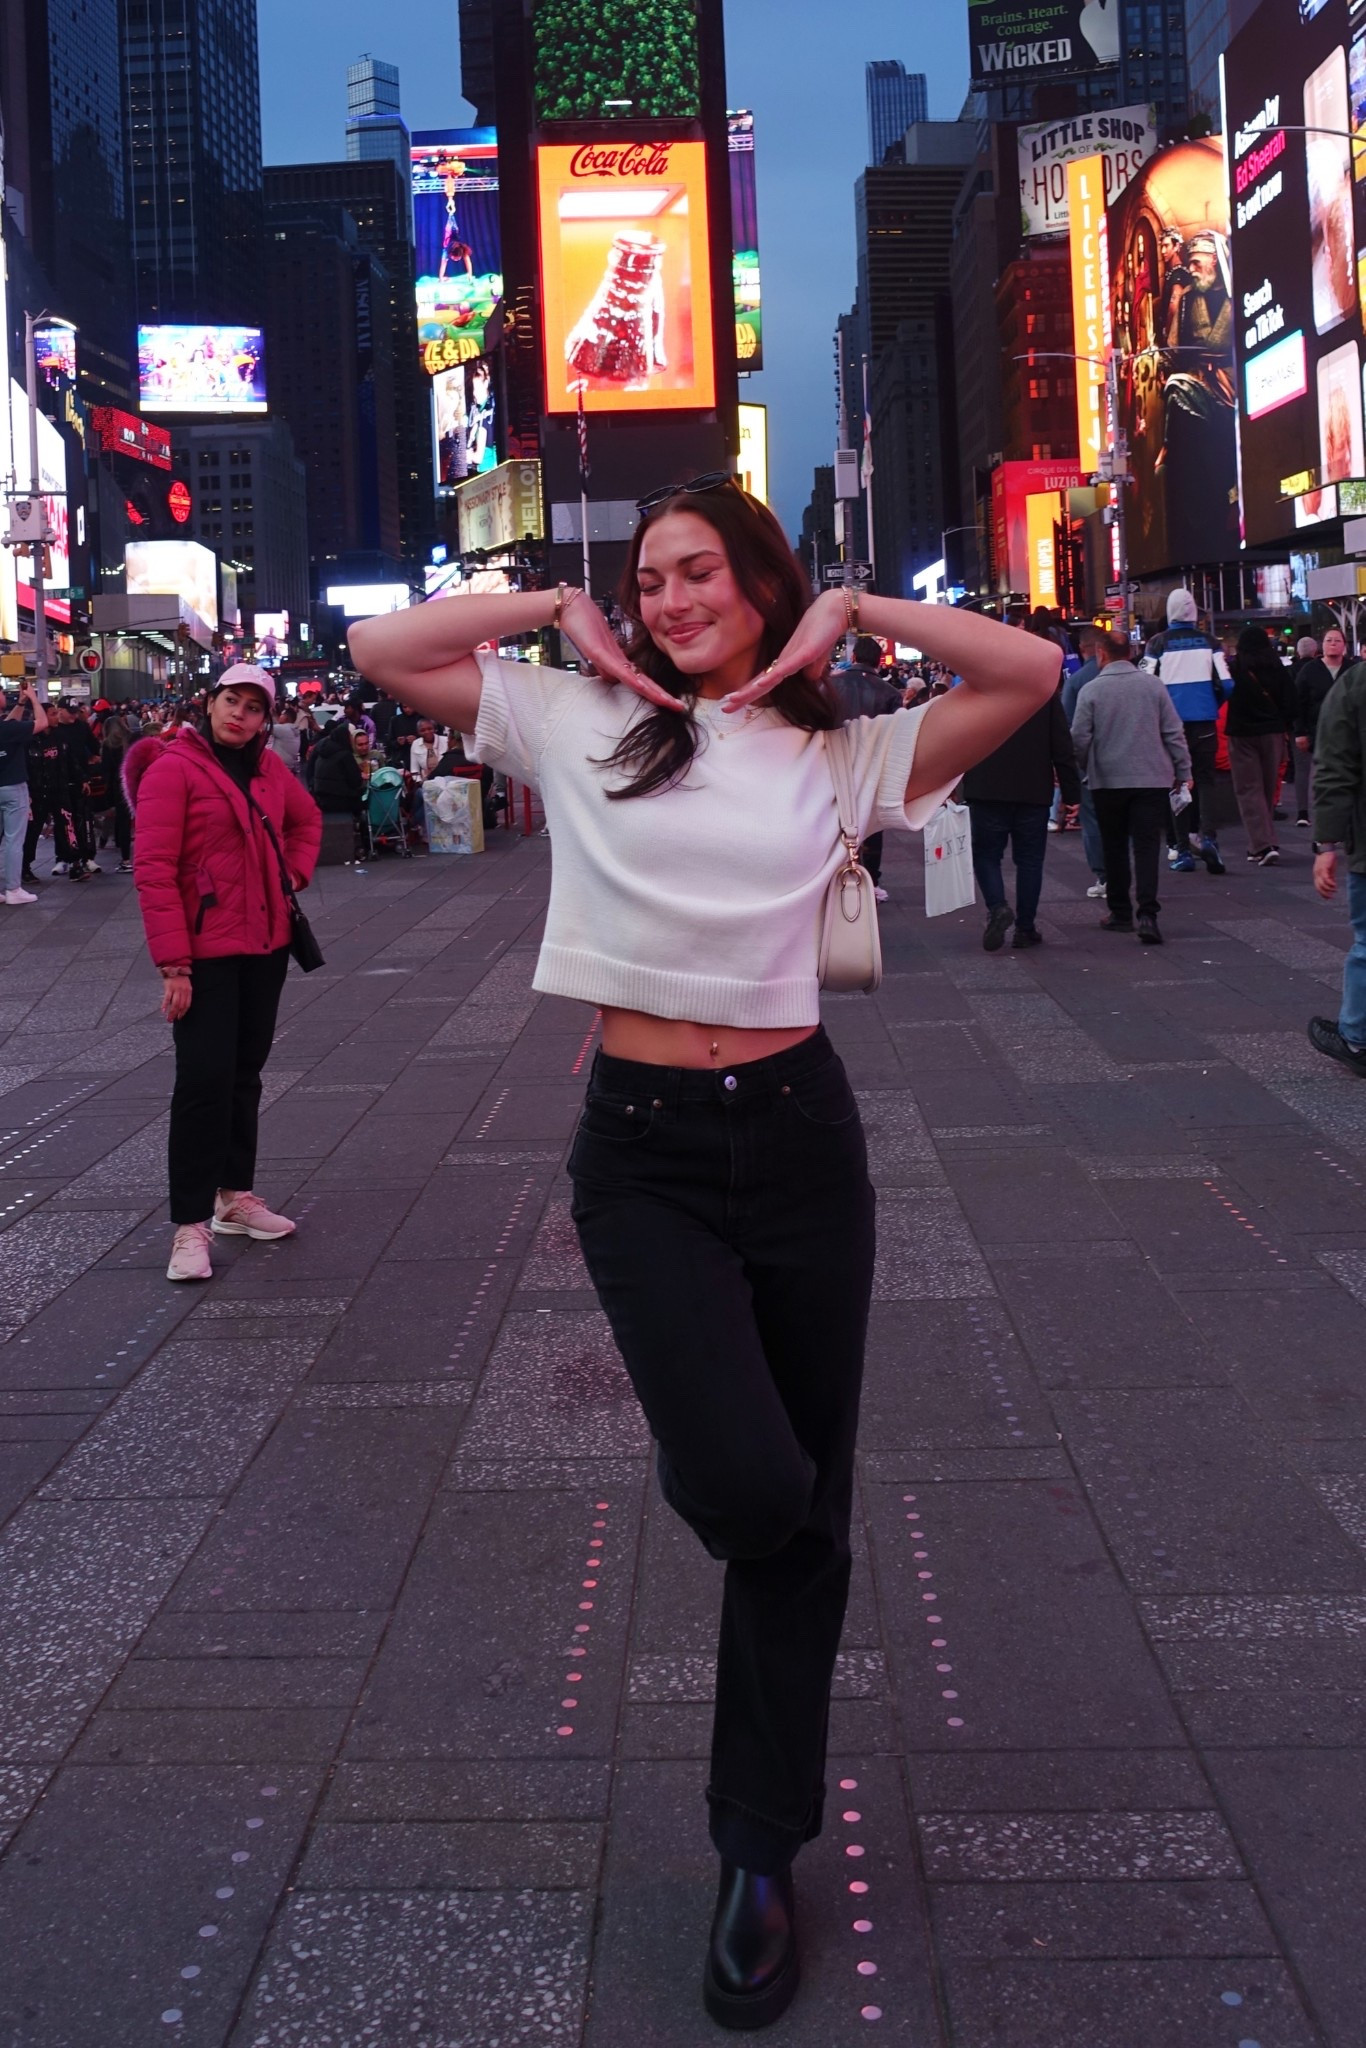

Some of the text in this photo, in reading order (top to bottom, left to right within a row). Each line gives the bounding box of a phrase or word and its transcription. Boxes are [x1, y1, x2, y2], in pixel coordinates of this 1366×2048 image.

[981, 5, 1069, 26] Brains. Heart.
[996, 21, 1053, 36] Courage.
[1032, 117, 1145, 162] LITTLE SHOP
[1078, 145, 1092, 153] OF
[570, 143, 672, 177] Coca-Cola
[1237, 130, 1285, 194] Ed Sheeran
[1255, 304, 1284, 341] TikTok
[1028, 466, 1055, 475] CIRQUE
[1045, 476, 1079, 490] LUZIA
[521, 464, 539, 536] HELLO!
[1038, 539, 1054, 594] NOW OPEN
[64, 588, 75, 598] 46
